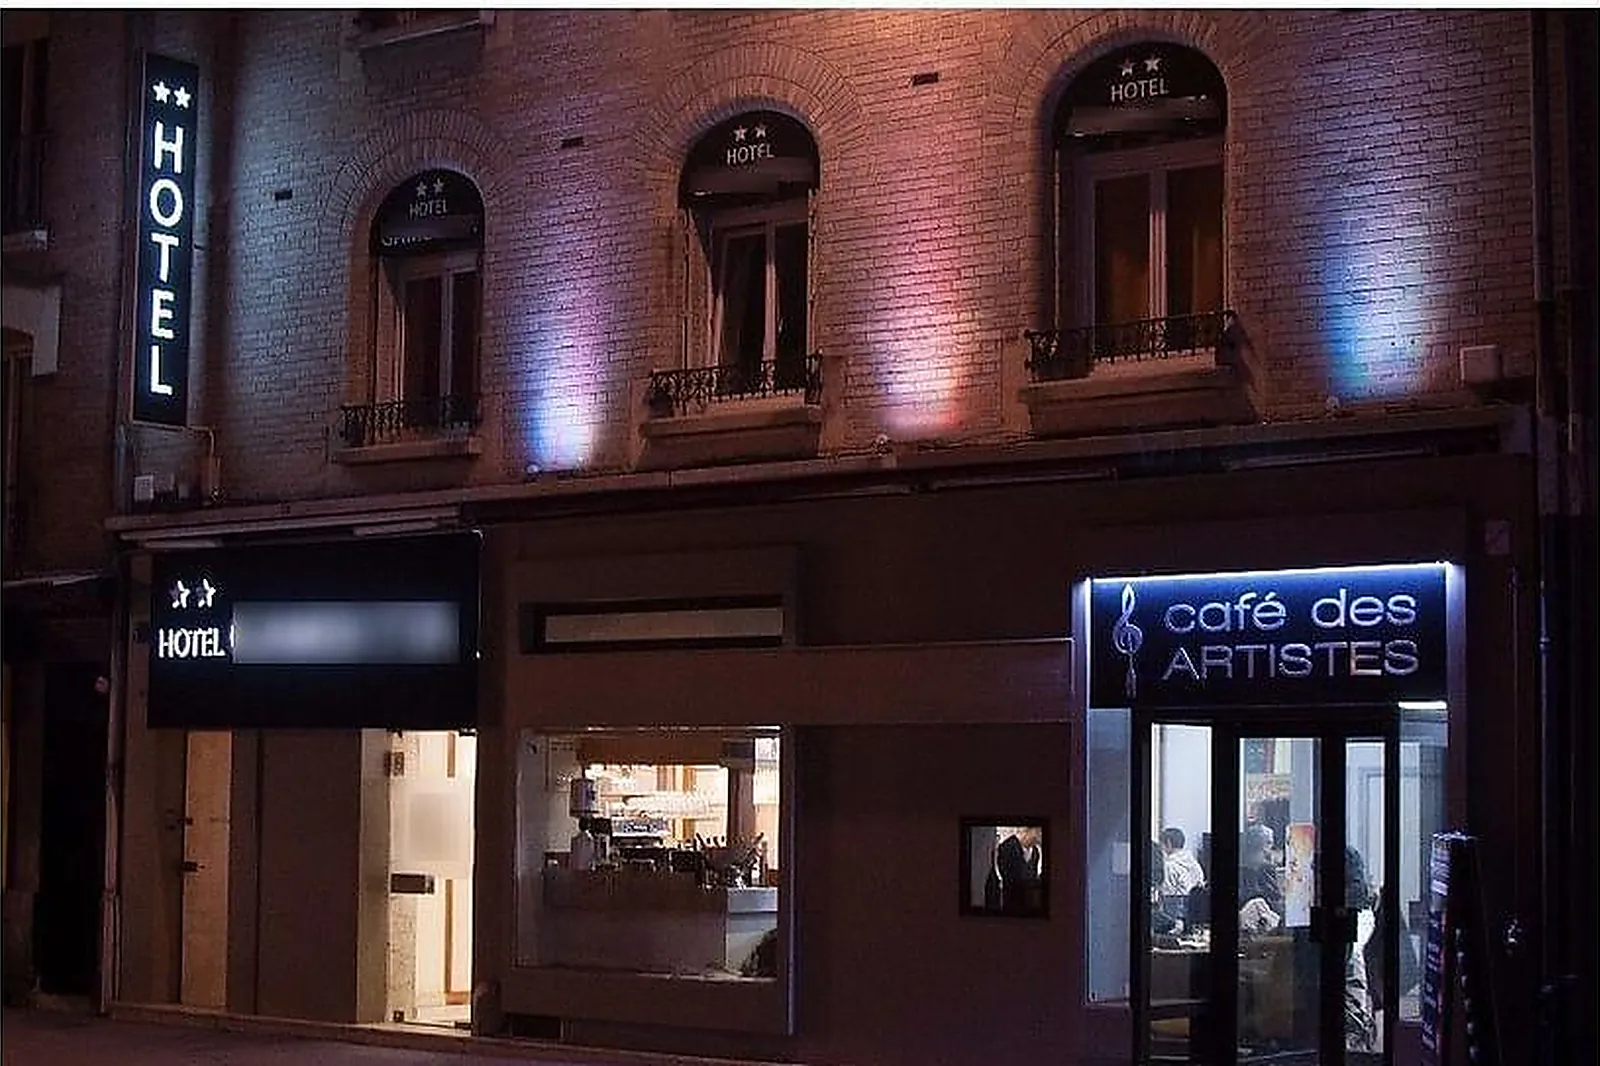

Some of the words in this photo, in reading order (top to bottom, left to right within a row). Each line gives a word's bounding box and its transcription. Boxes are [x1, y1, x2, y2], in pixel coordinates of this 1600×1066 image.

[1110, 77, 1170, 103] HOTEL
[726, 142, 775, 166] HOTEL
[150, 121, 184, 396] HOTEL
[1164, 590, 1287, 633] café
[1311, 587, 1417, 628] des
[157, 627, 227, 659] HOTEL
[1160, 638, 1420, 682] ARTISTES
